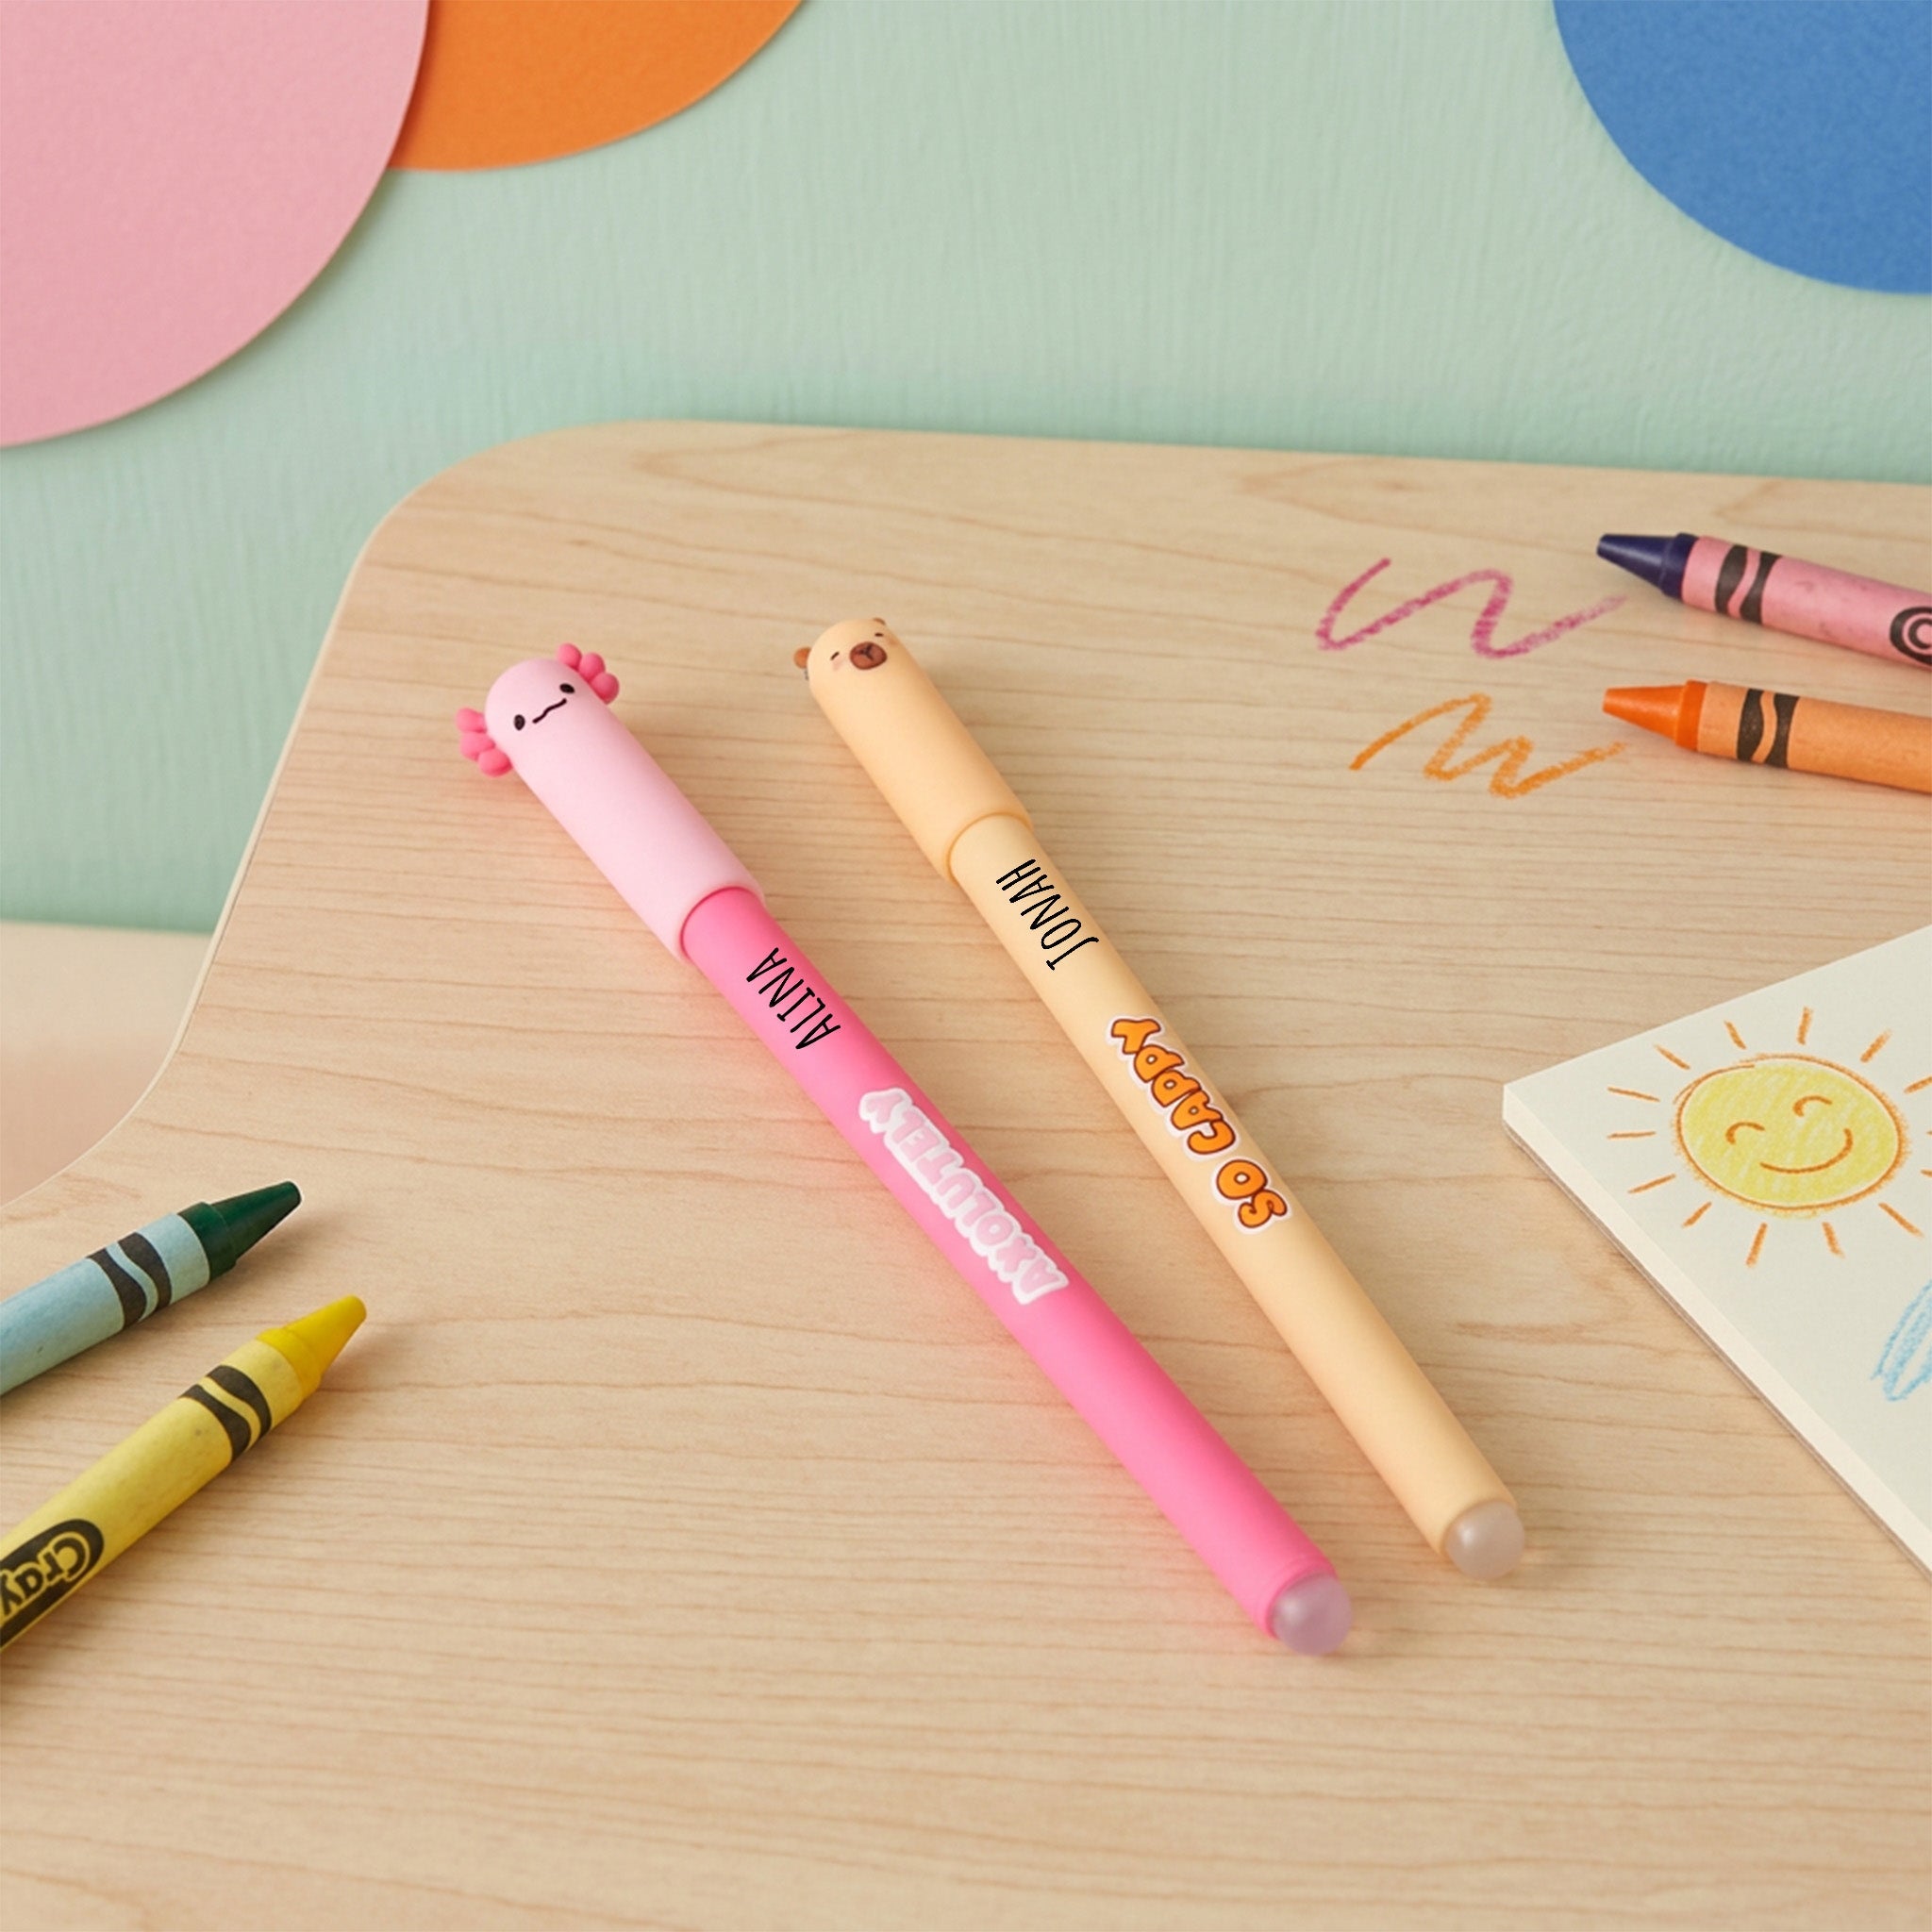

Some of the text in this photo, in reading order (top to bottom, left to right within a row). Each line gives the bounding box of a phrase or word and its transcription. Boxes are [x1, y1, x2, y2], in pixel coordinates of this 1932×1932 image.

[996, 858, 1099, 971] JONAH
[746, 947, 841, 1050] ALINA
[1109, 1017, 1289, 1229] SO CAPPY
[860, 1089, 1067, 1304] AXOLUTELY
[0, 1534, 89, 1619] Cray
